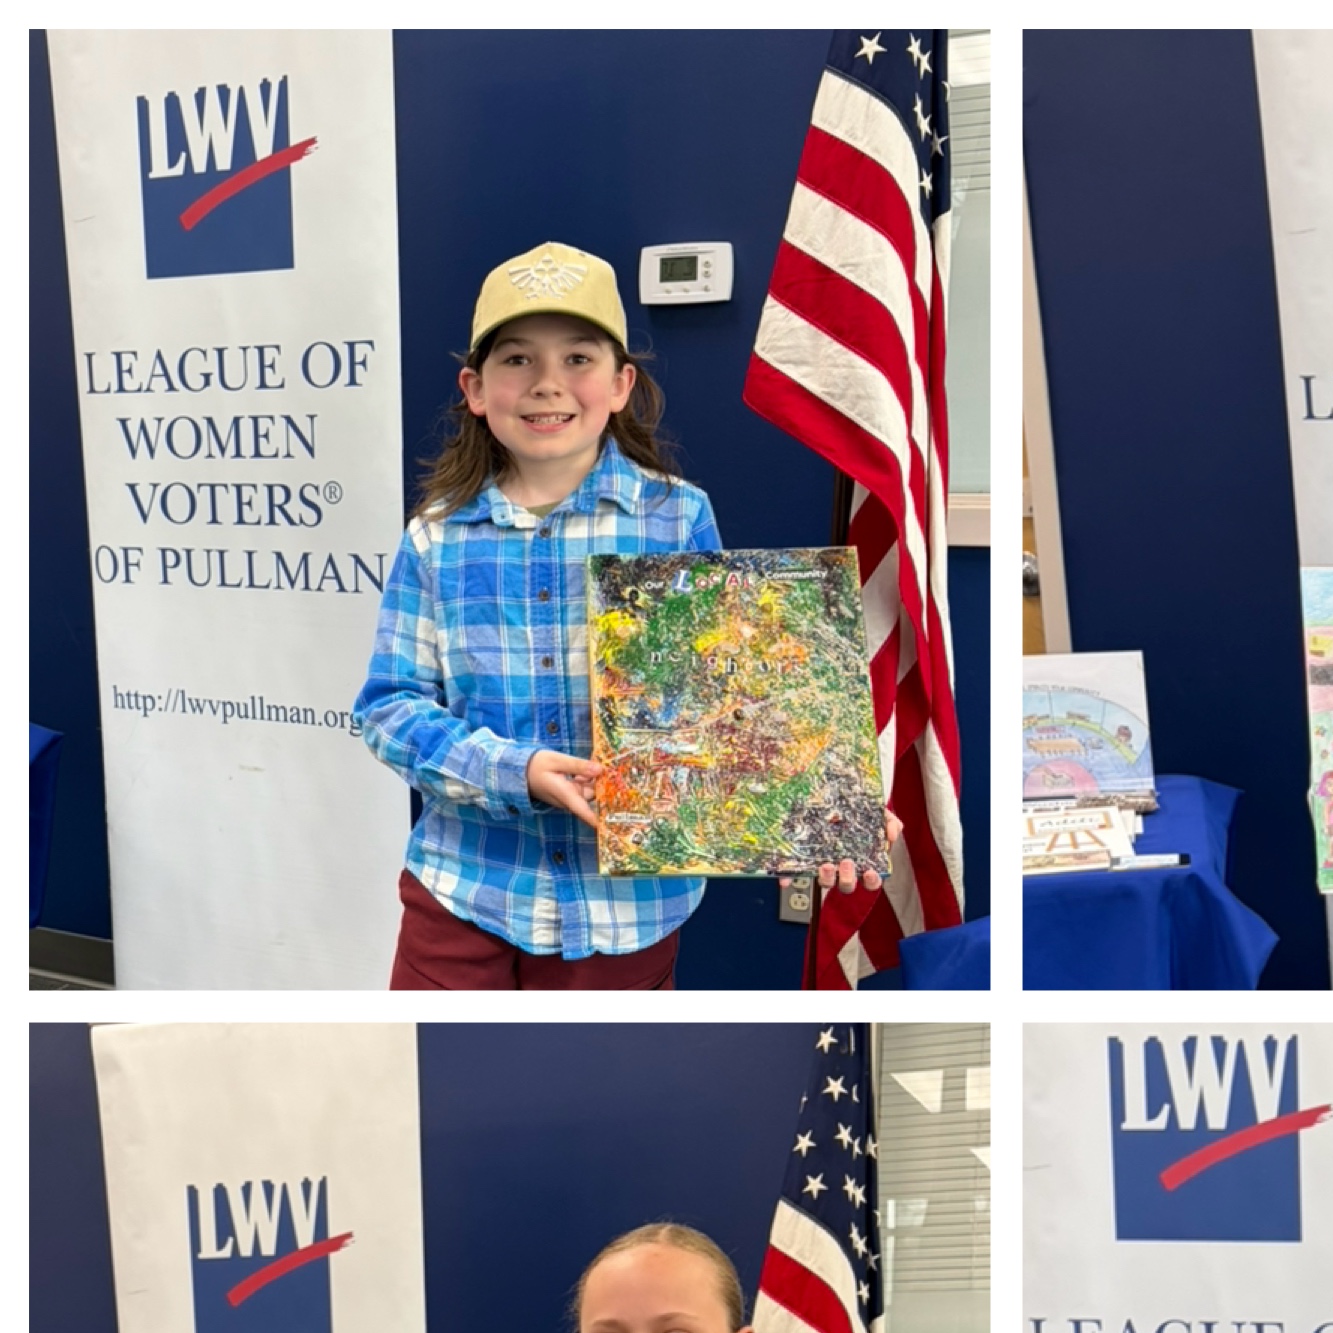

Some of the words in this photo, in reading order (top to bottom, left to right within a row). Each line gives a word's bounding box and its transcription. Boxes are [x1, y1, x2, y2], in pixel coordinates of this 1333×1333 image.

[147, 76, 288, 179] LWV
[84, 344, 286, 395] LEAGUE
[301, 340, 375, 389] OF
[116, 414, 318, 460] WOMEN
[95, 545, 143, 584] OF
[158, 546, 388, 594] PULLMAN
[765, 569, 828, 580] Community
[113, 685, 364, 736] http://lwvpullman.org
[1120, 1035, 1298, 1131] LWV
[198, 1176, 326, 1258] LWV
